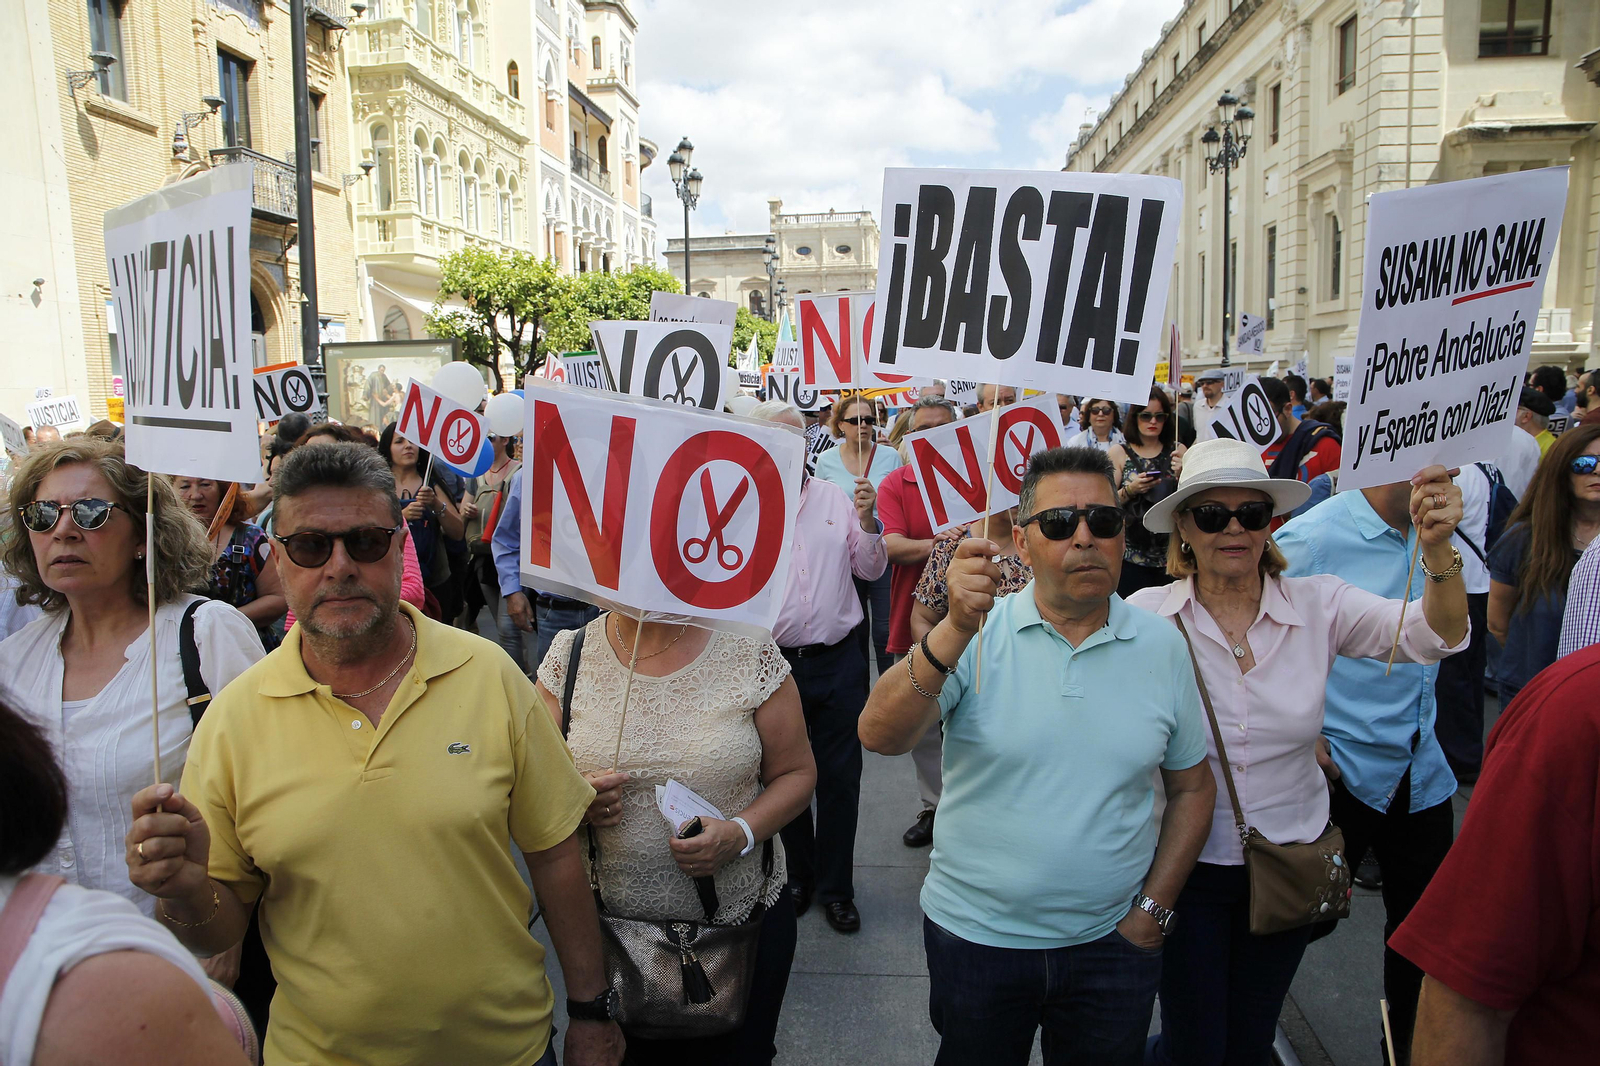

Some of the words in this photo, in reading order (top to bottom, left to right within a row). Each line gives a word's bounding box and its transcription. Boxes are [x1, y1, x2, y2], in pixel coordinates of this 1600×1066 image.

[879, 185, 1165, 376] ¡BASTA!
[1376, 235, 1456, 310] SUSANA
[1454, 227, 1488, 294] NO
[1486, 218, 1546, 285] SANA.
[800, 297, 913, 384] N
[1360, 342, 1428, 404] ¡Pobre
[1431, 310, 1527, 377] Andalucía
[28, 400, 81, 428] ¡JUSTICIA!
[252, 370, 313, 419] NO
[399, 382, 480, 464] NO
[768, 374, 818, 410] NO
[1212, 383, 1276, 446] NO
[1353, 425, 1370, 470] y
[1370, 401, 1438, 461] España
[1441, 401, 1471, 441] con
[1470, 376, 1517, 428] Díaz!
[530, 400, 786, 610] NO
[911, 407, 1061, 527] NO
